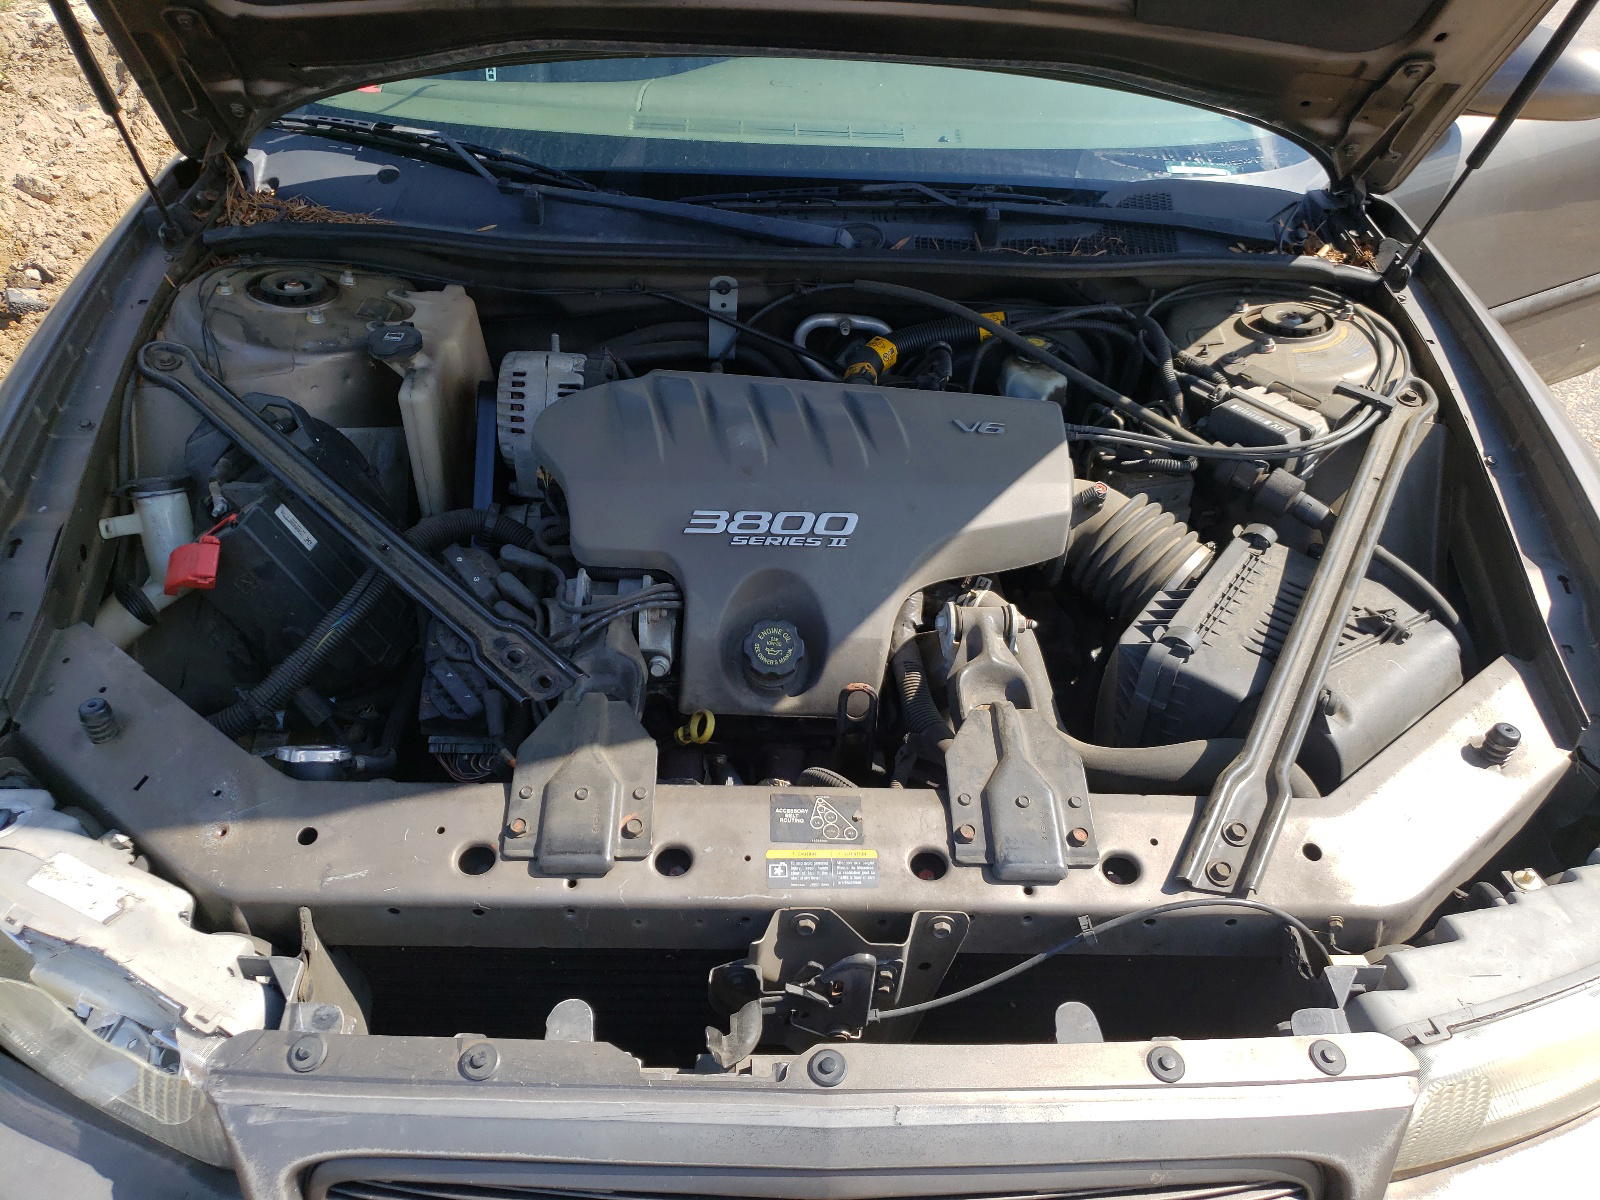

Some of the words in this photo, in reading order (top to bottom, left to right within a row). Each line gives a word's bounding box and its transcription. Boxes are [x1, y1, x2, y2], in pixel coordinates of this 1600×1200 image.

[952, 418, 1006, 434] V6
[683, 510, 859, 536] 3800
[730, 536, 823, 547] SERIES
[827, 537, 850, 547] II
[757, 627, 783, 640] ENGINE
[782, 632, 792, 643] OIL
[778, 647, 794, 664] MANUAL
